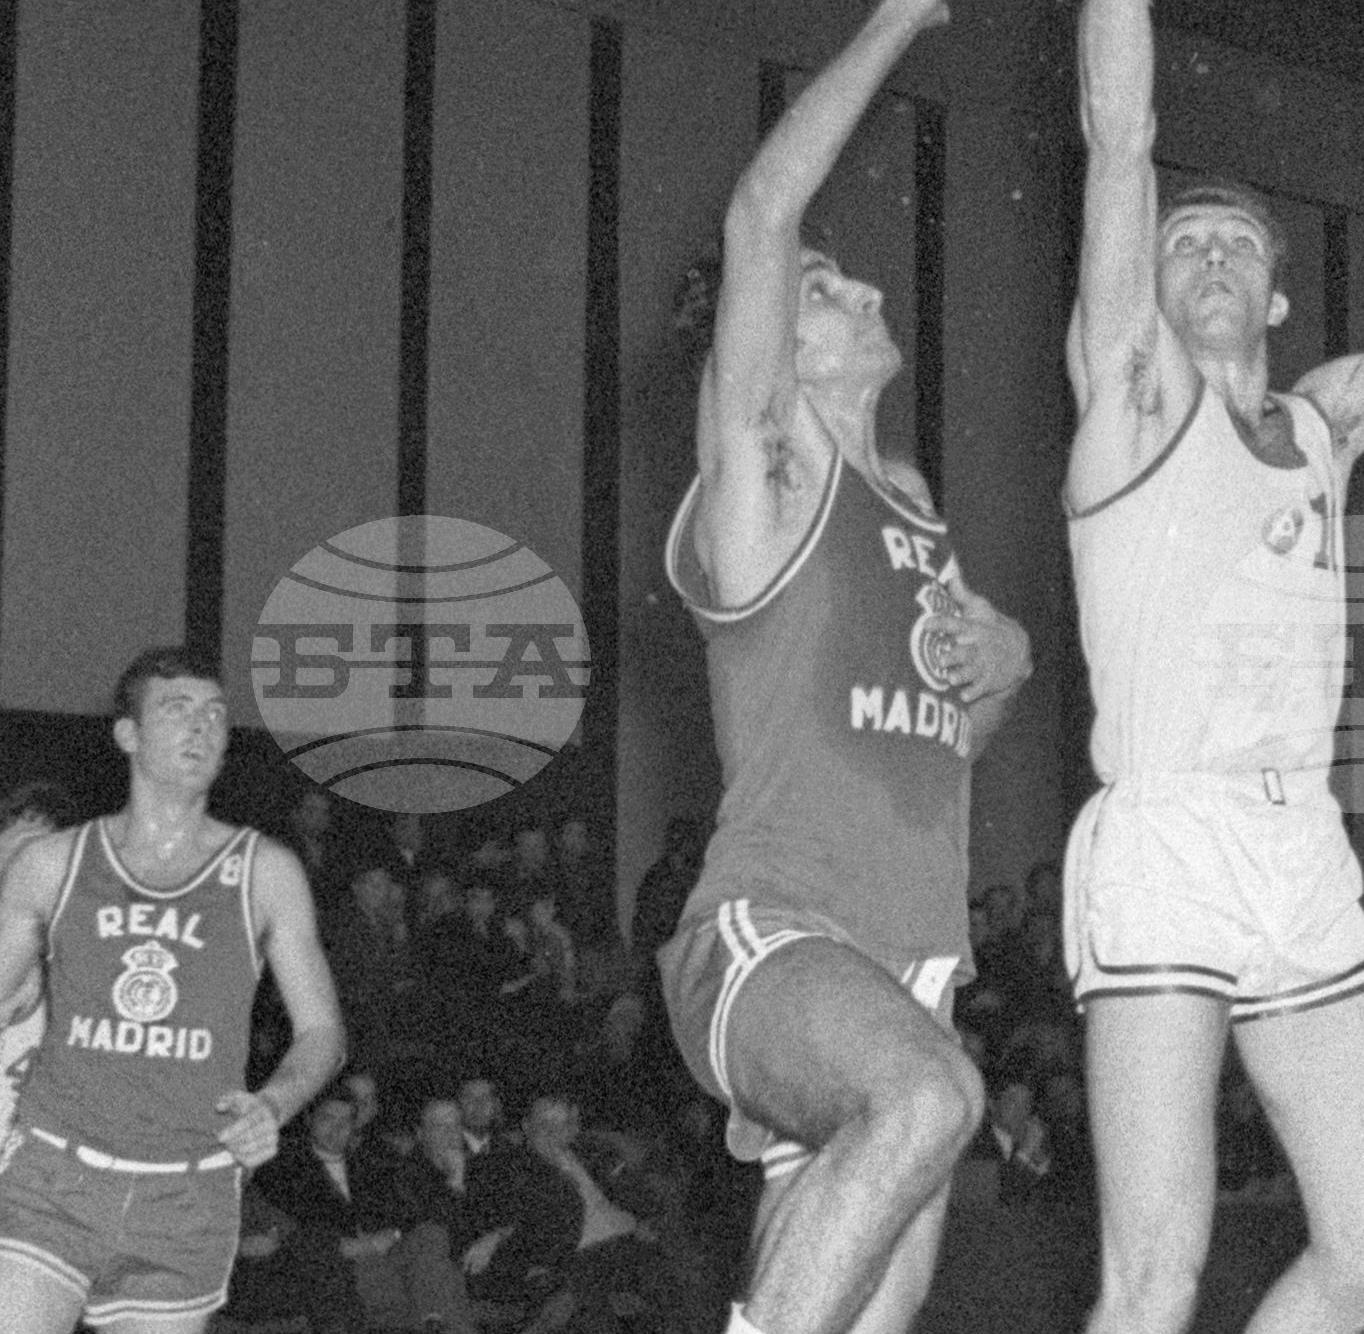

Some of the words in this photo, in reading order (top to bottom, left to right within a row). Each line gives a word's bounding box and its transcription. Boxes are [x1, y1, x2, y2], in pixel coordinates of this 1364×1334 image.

[881, 525, 961, 584] REA
[96, 903, 206, 949] REAL
[67, 1015, 213, 1061] MADRID
